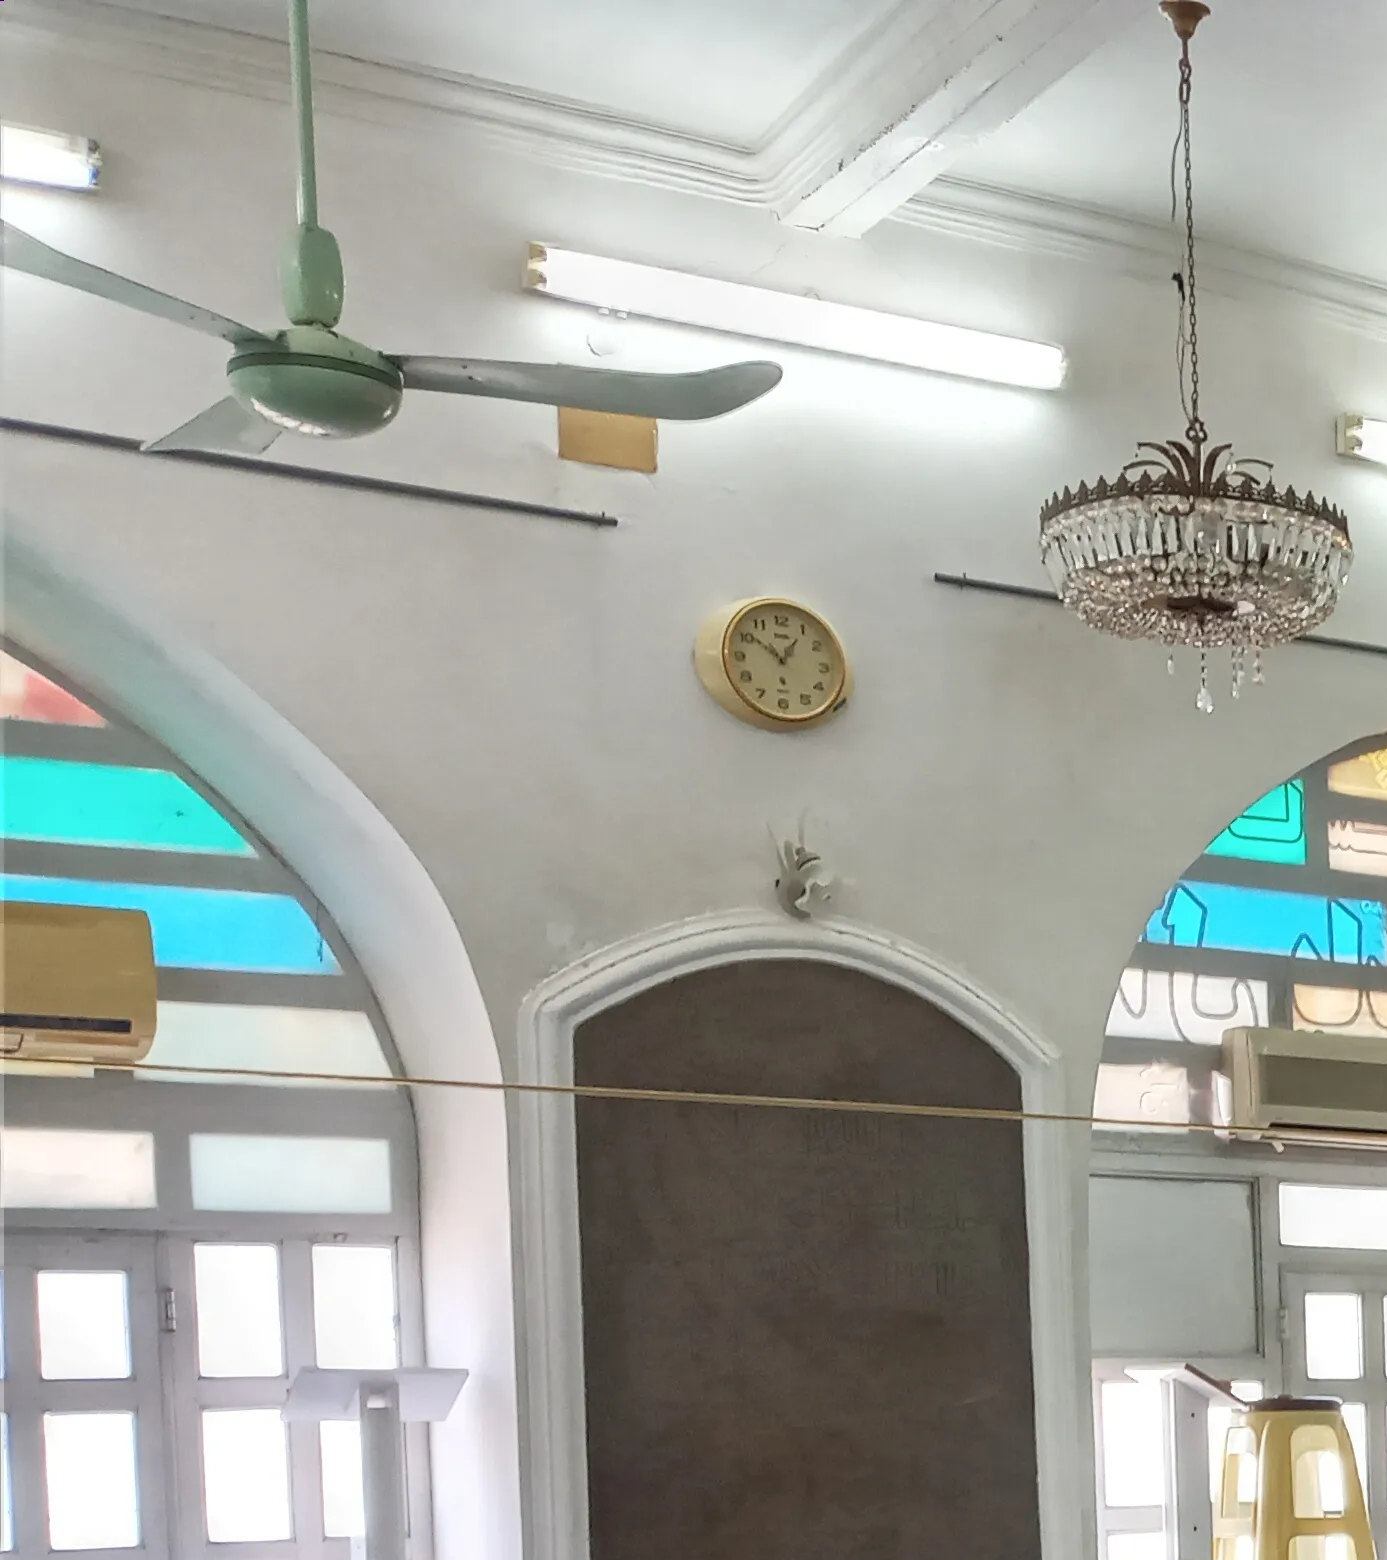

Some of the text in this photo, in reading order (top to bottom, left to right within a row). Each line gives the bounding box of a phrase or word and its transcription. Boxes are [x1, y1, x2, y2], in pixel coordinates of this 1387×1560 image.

[754, 619, 766, 631] 11
[774, 615, 789, 627] 12
[800, 624, 805, 635] 1
[741, 632, 754, 643] 10
[812, 640, 822, 652] 2
[813, 681, 825, 691] 4
[756, 688, 766, 698] 7
[778, 698, 789, 709] 6
[800, 693, 811, 705] 5
